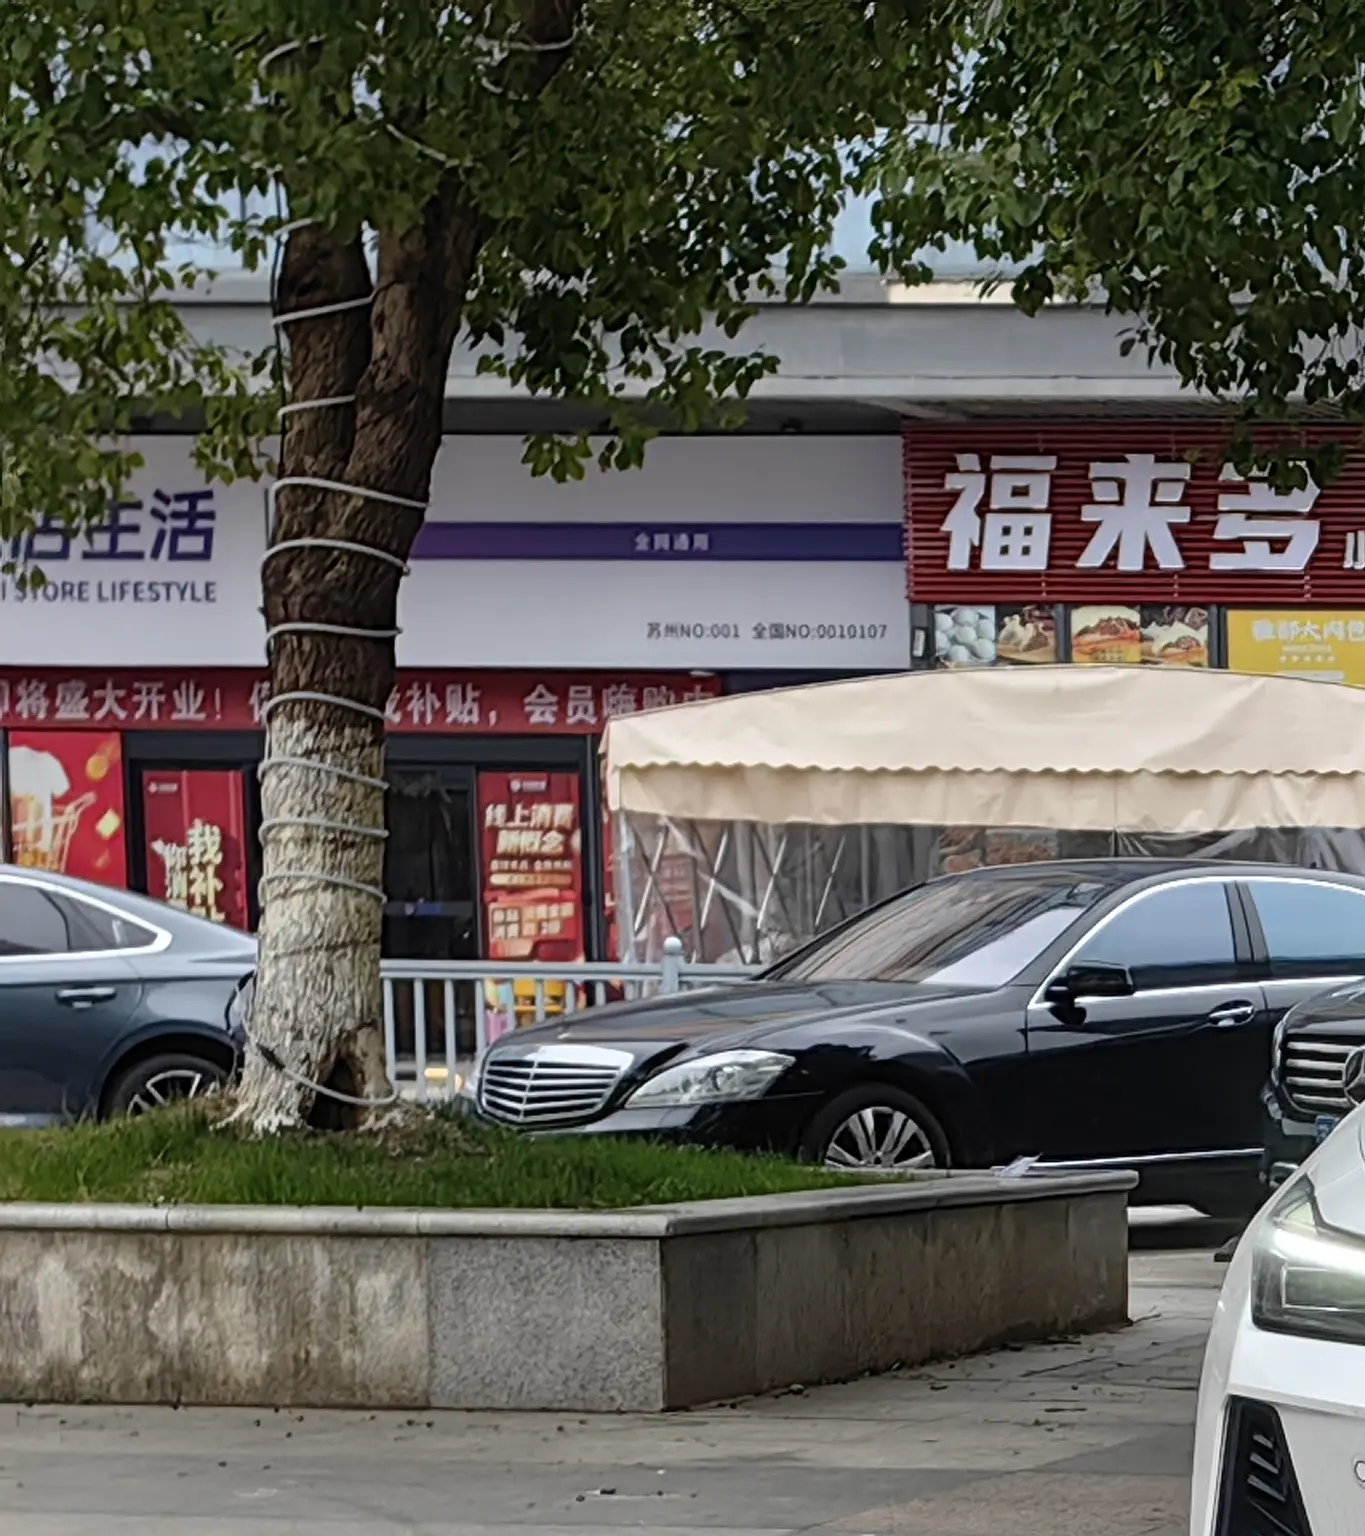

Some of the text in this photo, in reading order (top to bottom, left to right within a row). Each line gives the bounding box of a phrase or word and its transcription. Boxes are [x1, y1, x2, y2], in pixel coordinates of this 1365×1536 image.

[941, 454, 1321, 572] 福来多
[97, 581, 217, 603] LIFESTYLE
[646, 622, 888, 640] 苏州NO:001 全国NO:0010107
